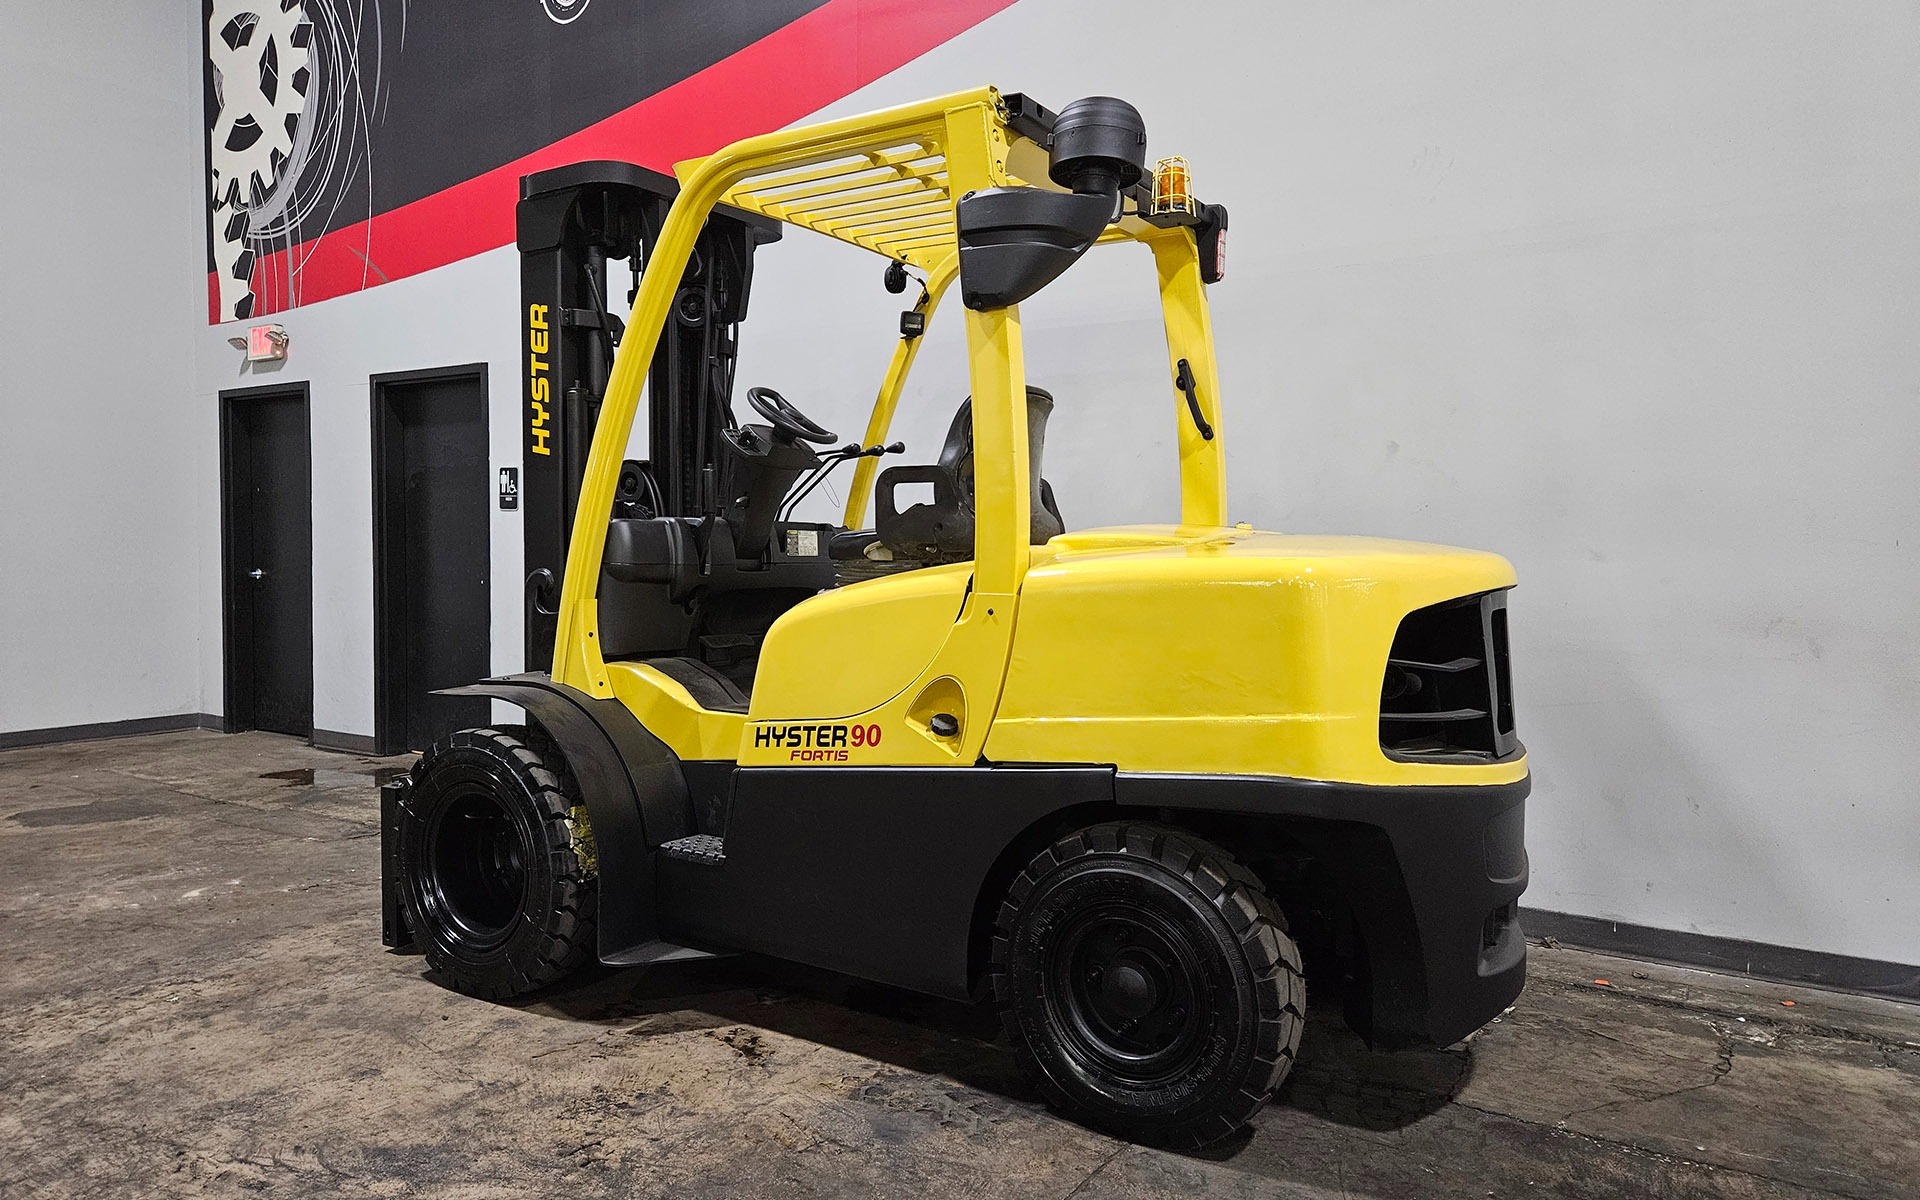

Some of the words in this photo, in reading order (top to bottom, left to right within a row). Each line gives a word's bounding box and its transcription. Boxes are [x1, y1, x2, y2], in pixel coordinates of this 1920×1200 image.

[530, 303, 550, 456] HYSTER
[754, 725, 848, 748] HYSTER
[851, 724, 881, 748] 90
[790, 750, 848, 761] FORTIS
